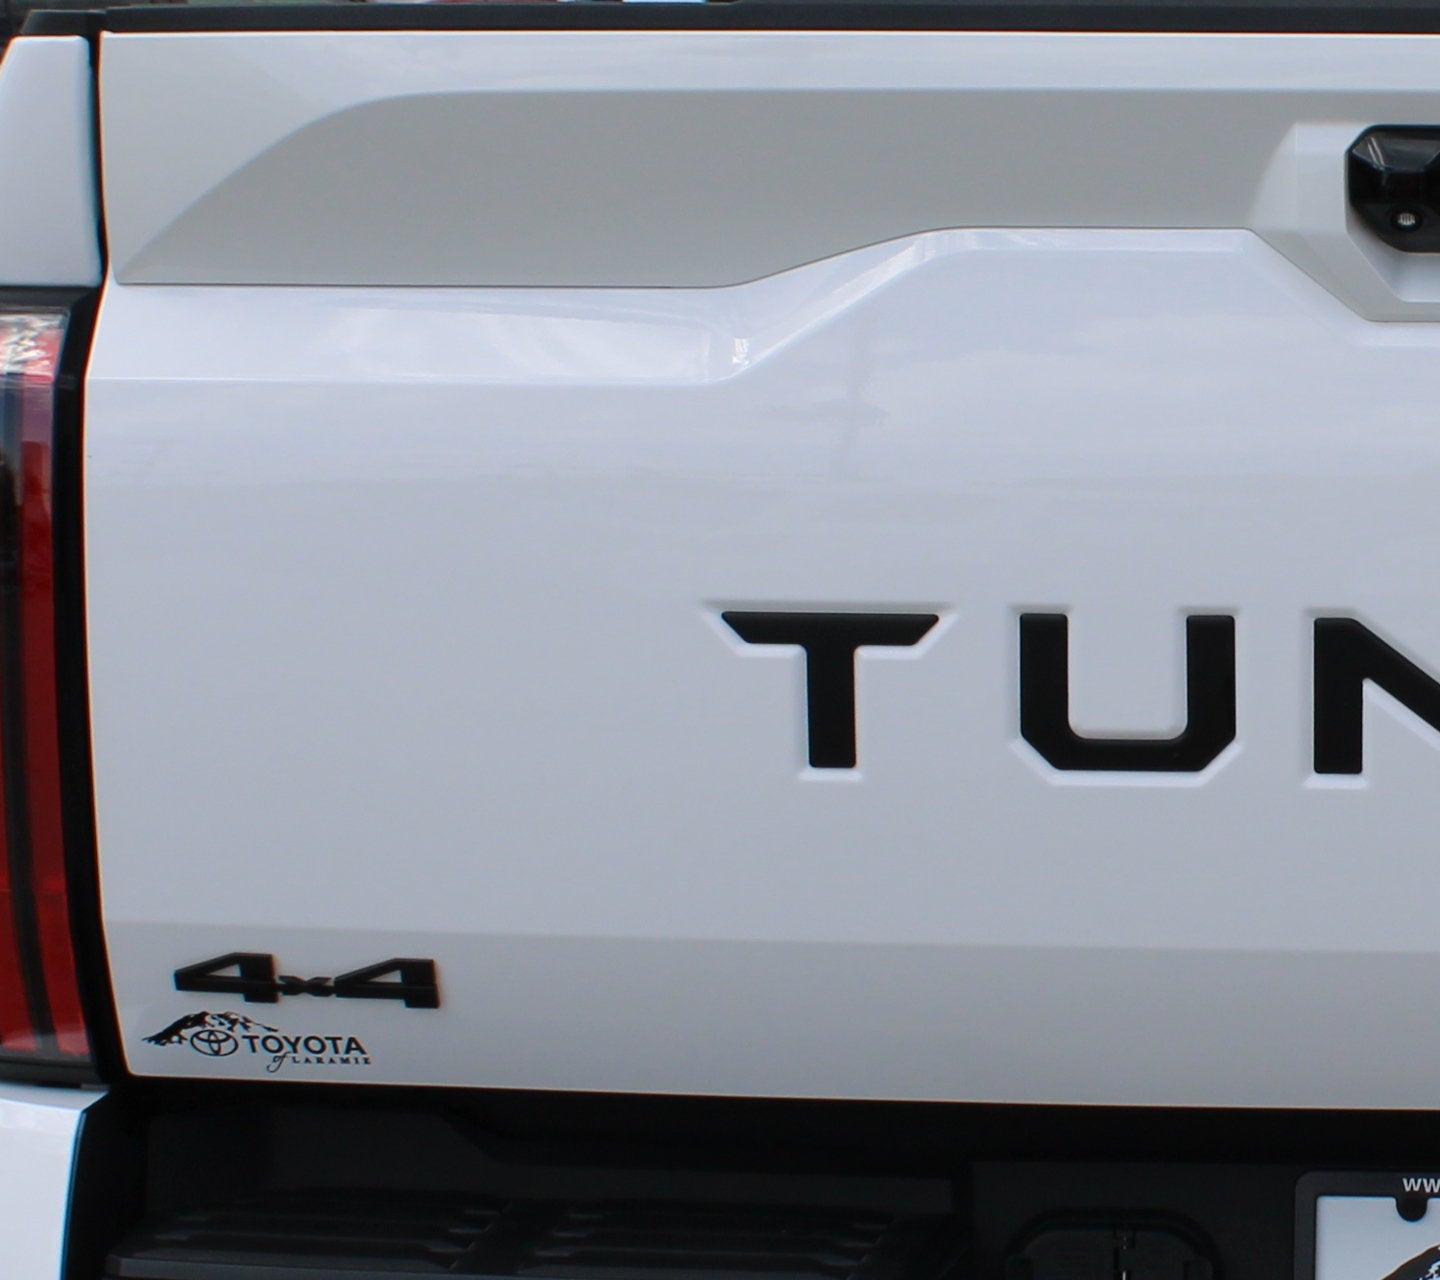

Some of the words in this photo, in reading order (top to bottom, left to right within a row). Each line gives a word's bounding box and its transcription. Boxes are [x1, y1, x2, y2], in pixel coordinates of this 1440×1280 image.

[174, 952, 440, 1009] 4x4
[241, 1035, 367, 1055] TOYOTA
[266, 1051, 291, 1073] of
[292, 1056, 371, 1065] LARAMIE
